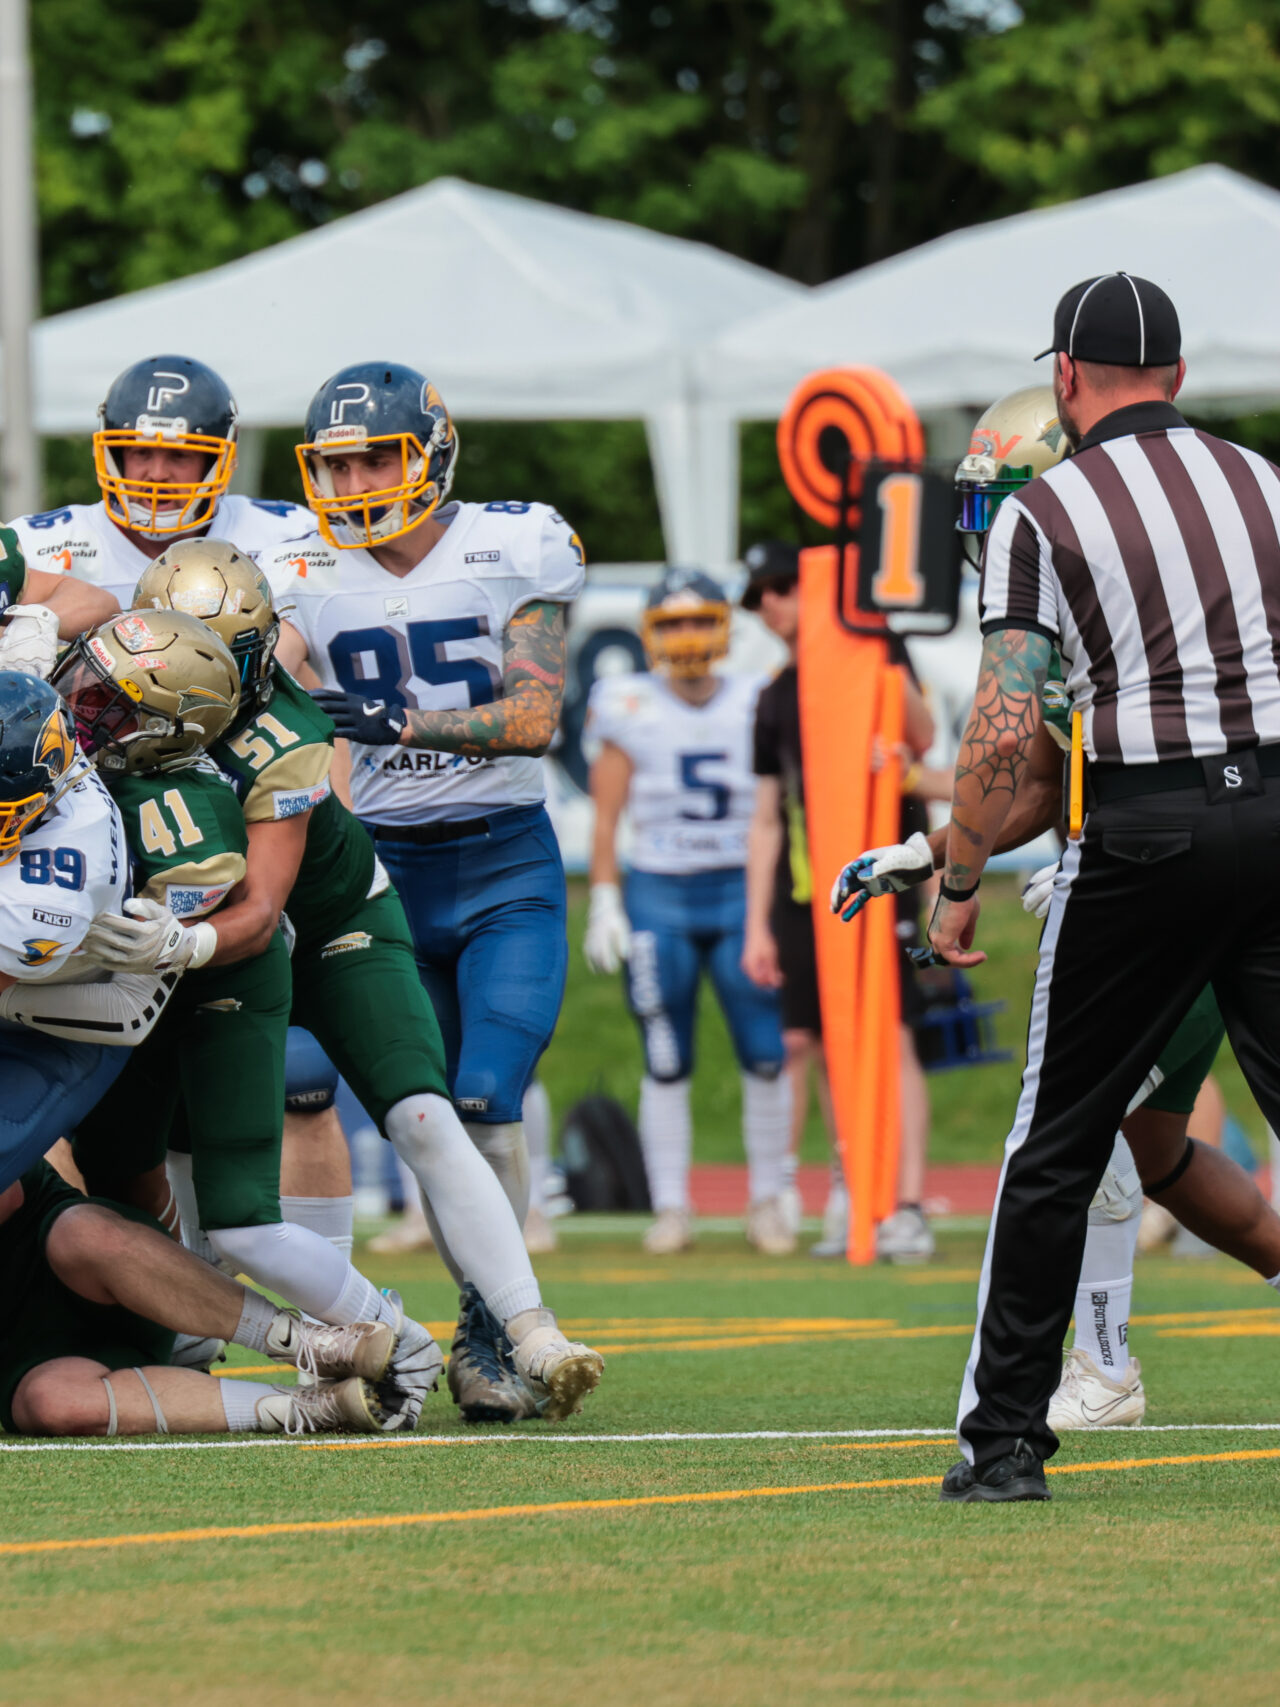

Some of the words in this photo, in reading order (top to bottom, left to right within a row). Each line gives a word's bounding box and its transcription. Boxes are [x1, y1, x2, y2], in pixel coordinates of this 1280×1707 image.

[871, 473, 925, 607] 1
[89, 640, 113, 668] Riddell
[327, 614, 505, 711] 85
[227, 711, 301, 772] 51
[277, 794, 310, 807] WAGNER
[677, 752, 733, 821] 5
[1223, 765, 1243, 789] S
[138, 788, 204, 857] 41
[19, 846, 87, 893] 89
[32, 908, 72, 928] TNKD
[170, 889, 204, 901] WAGNER
